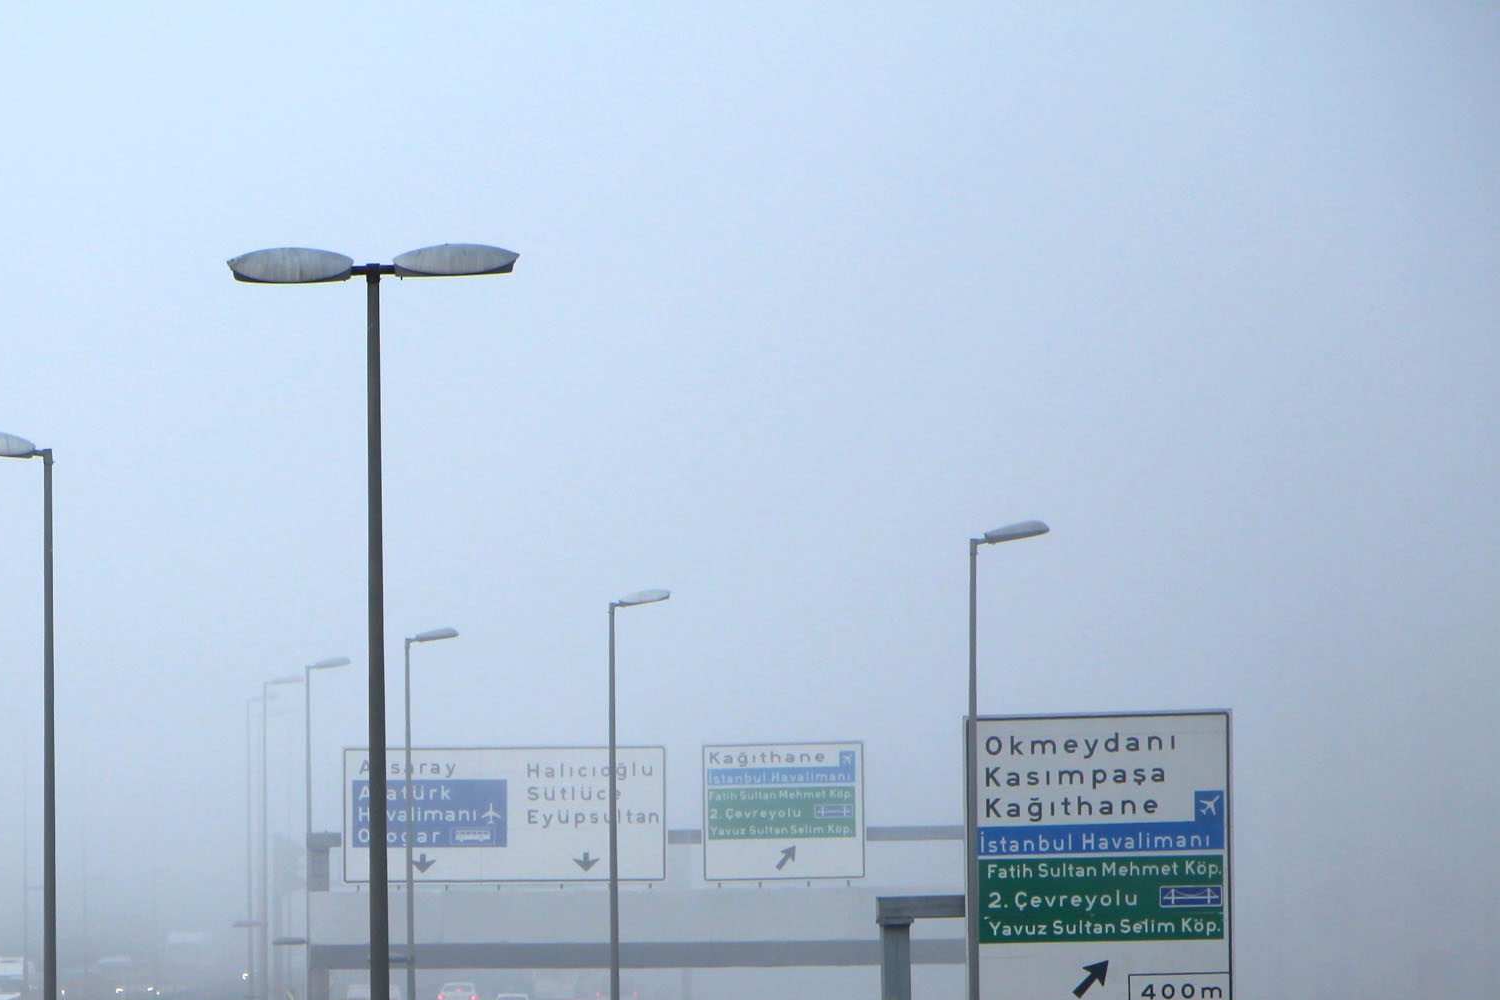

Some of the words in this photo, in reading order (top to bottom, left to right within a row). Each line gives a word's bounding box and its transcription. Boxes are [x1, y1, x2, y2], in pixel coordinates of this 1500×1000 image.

[985, 732, 1176, 759] Okmeydanı
[359, 759, 456, 777] Asaray
[709, 751, 826, 767] Kağıthane
[527, 762, 653, 780] Halıcıoğlu
[709, 773, 766, 785] İstanbul
[771, 771, 850, 783] Havalimanı
[985, 766, 1165, 790] Kasımpaşa
[359, 784, 451, 800] Aatürk
[709, 791, 737, 801] Fatih
[740, 791, 777, 800] Sultan
[779, 789, 826, 799] Mehmet
[358, 806, 477, 822] Hvalimanı
[725, 807, 802, 820] Çevreyolu
[985, 796, 1158, 822] Kağıthane
[710, 825, 746, 836] Yavuz
[750, 825, 788, 835] Sultan
[790, 824, 827, 834] Selim
[980, 832, 1072, 853] İstanbul
[1082, 832, 1210, 850] Havalimanı
[987, 863, 1033, 879] Fatih
[1038, 863, 1097, 878] Sultan
[1102, 861, 1178, 877] Mehmet
[1185, 860, 1222, 878] Köp.
[988, 892, 1008, 909] 2.
[1015, 890, 1138, 911] Çevreyolu
[989, 921, 1047, 936] Yavuz
[1053, 920, 1115, 935] Sultan
[1120, 919, 1175, 933] Selim
[1181, 918, 1221, 936] Köp.
